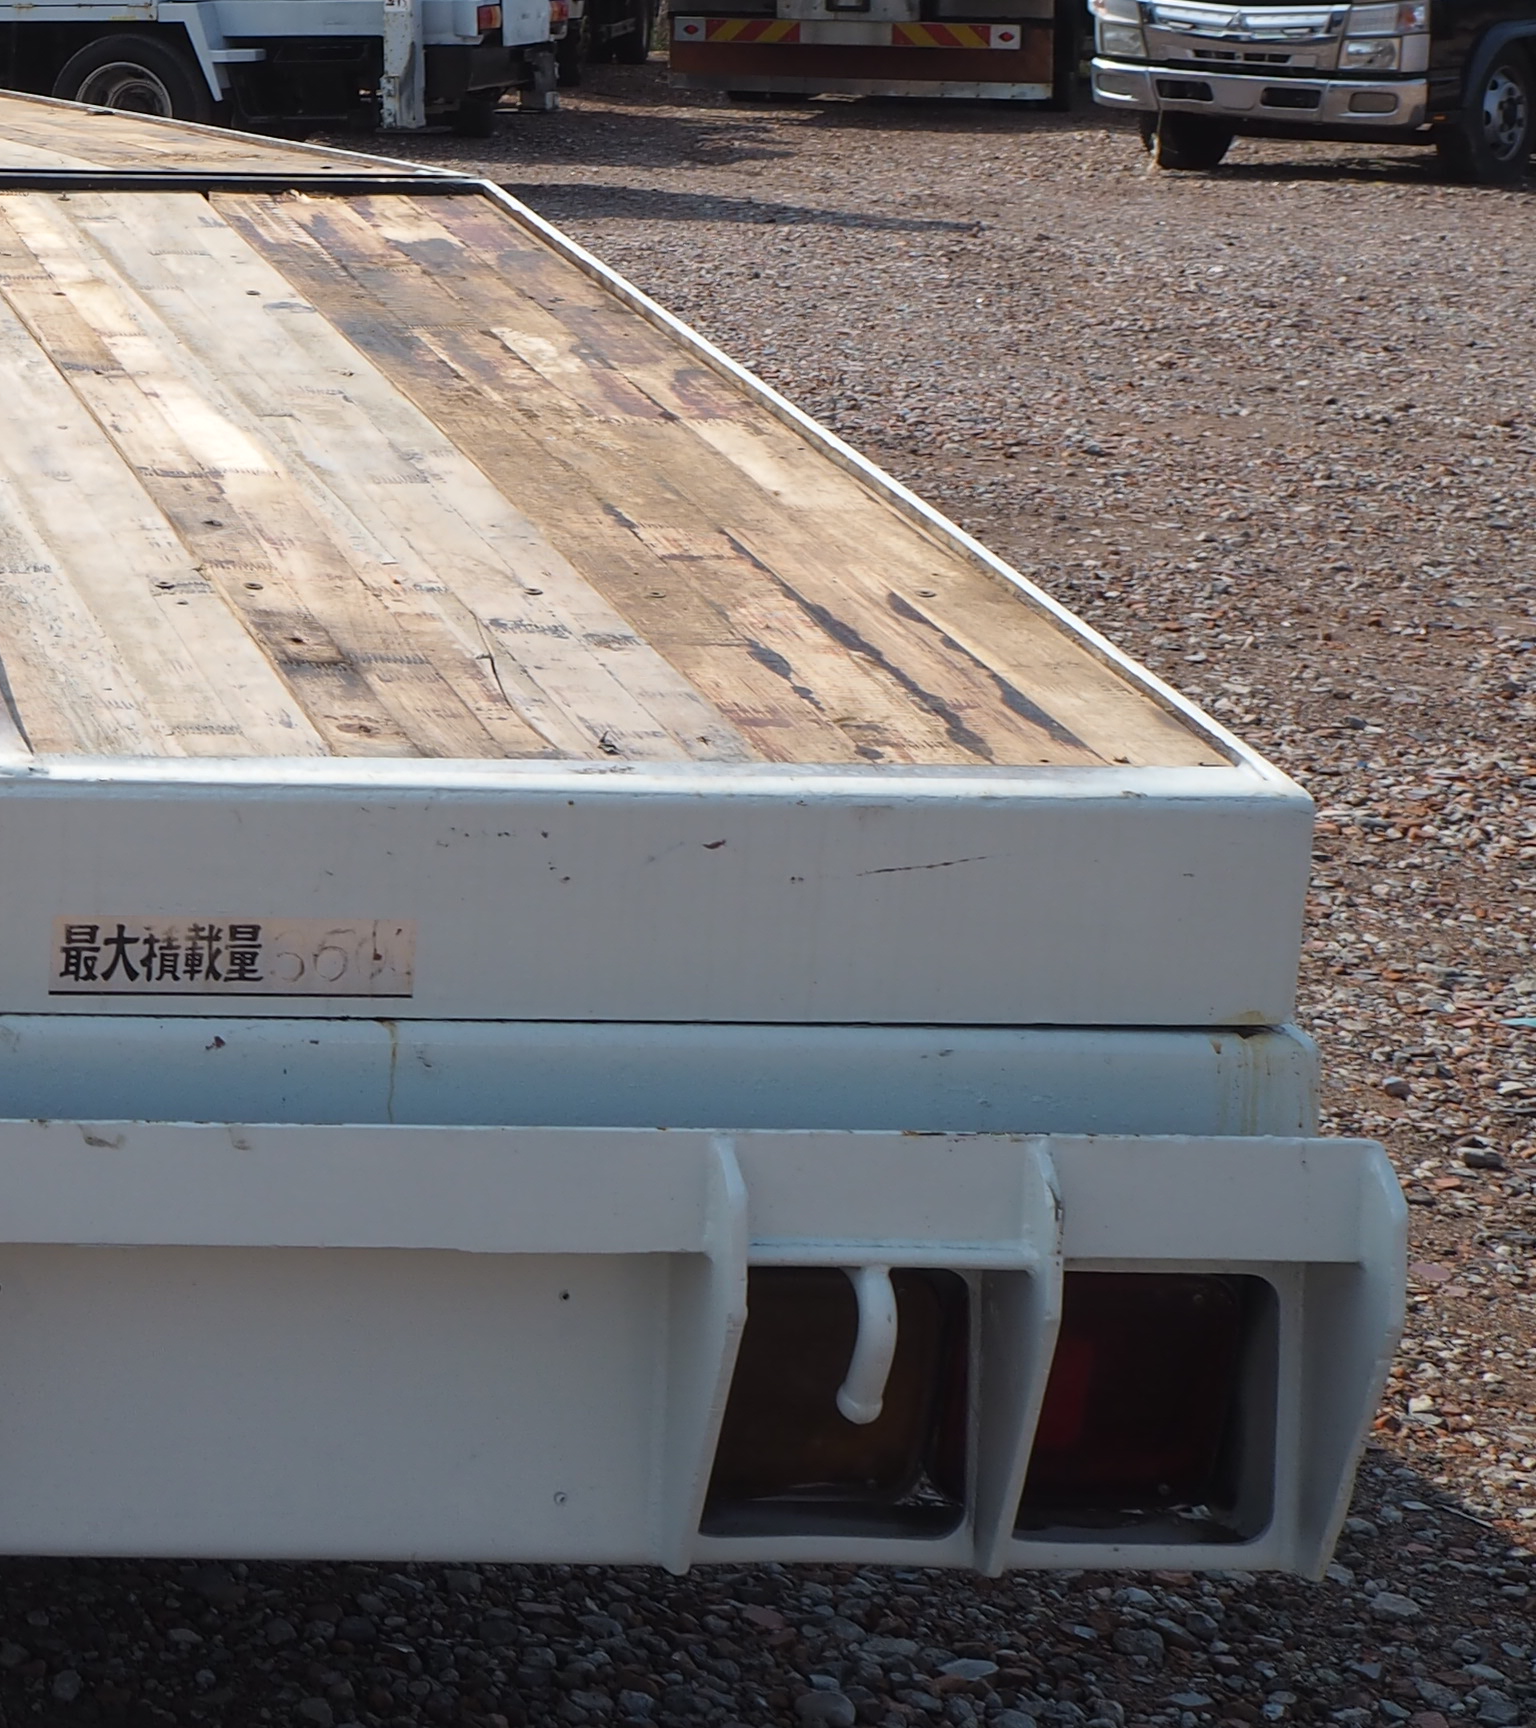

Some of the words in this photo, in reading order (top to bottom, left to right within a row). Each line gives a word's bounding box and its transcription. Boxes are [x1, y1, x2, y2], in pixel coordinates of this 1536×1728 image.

[58, 922, 265, 983] 最大積載量
